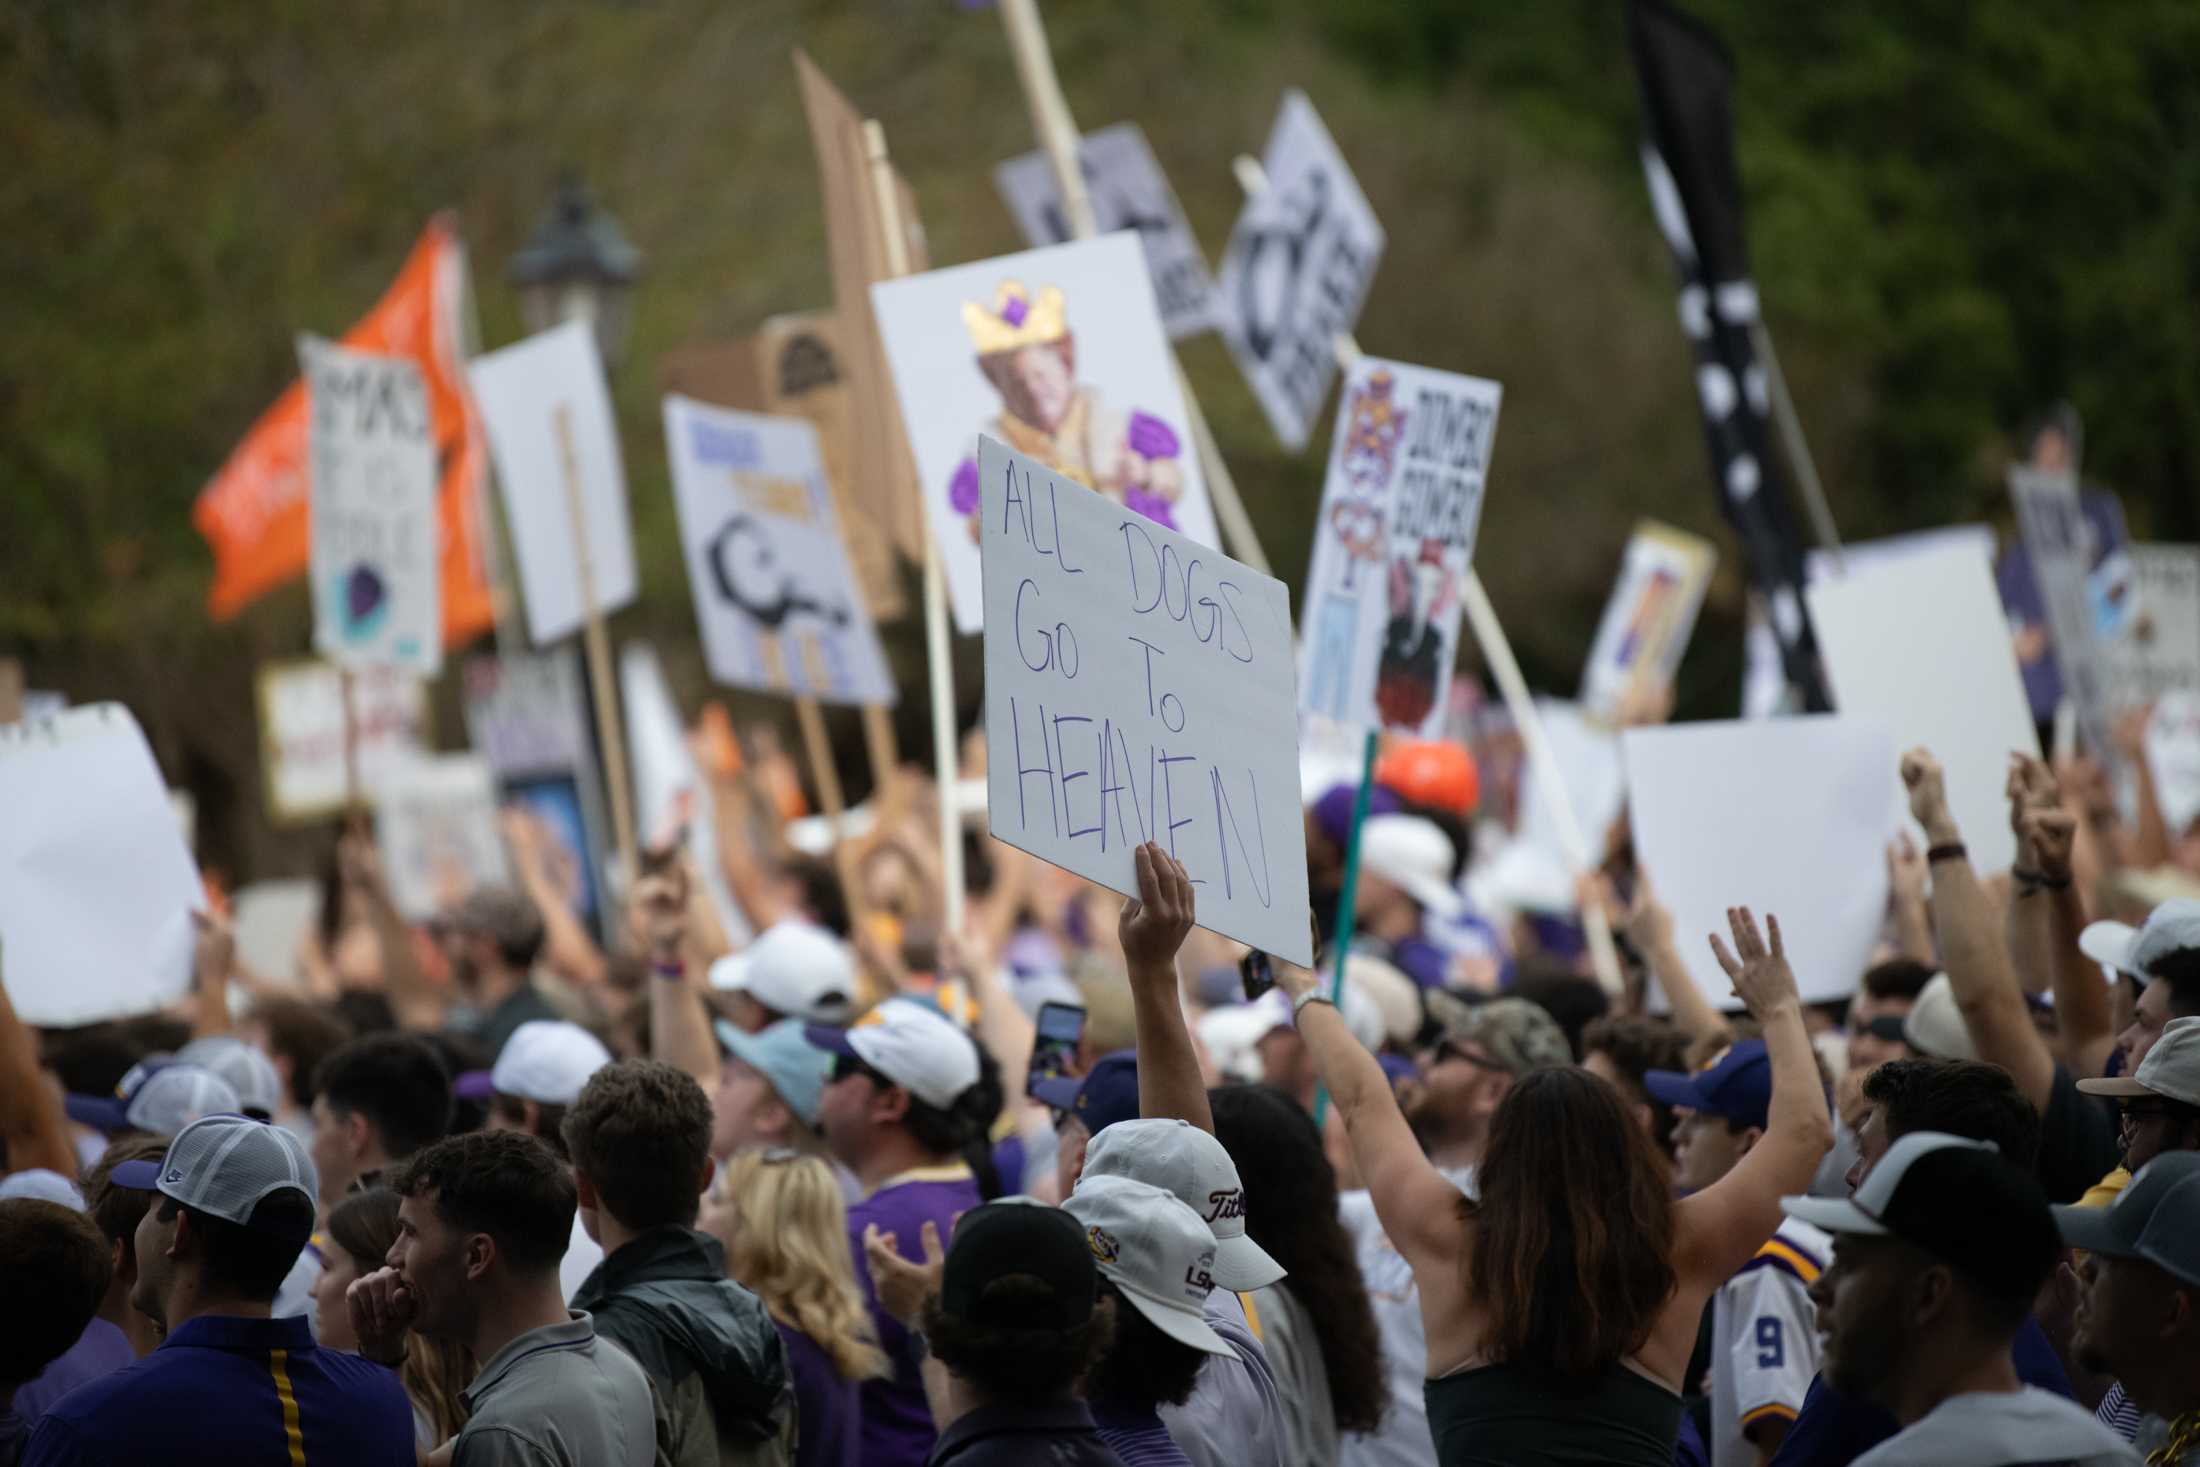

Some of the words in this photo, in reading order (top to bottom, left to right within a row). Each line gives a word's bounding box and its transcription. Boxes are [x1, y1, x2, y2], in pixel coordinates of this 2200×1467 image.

[1004, 459, 1083, 573] ALL
[1119, 522, 1254, 663] DOGS
[1010, 696, 1271, 908] HEAVEN
[1756, 1316, 1784, 1368] 9
